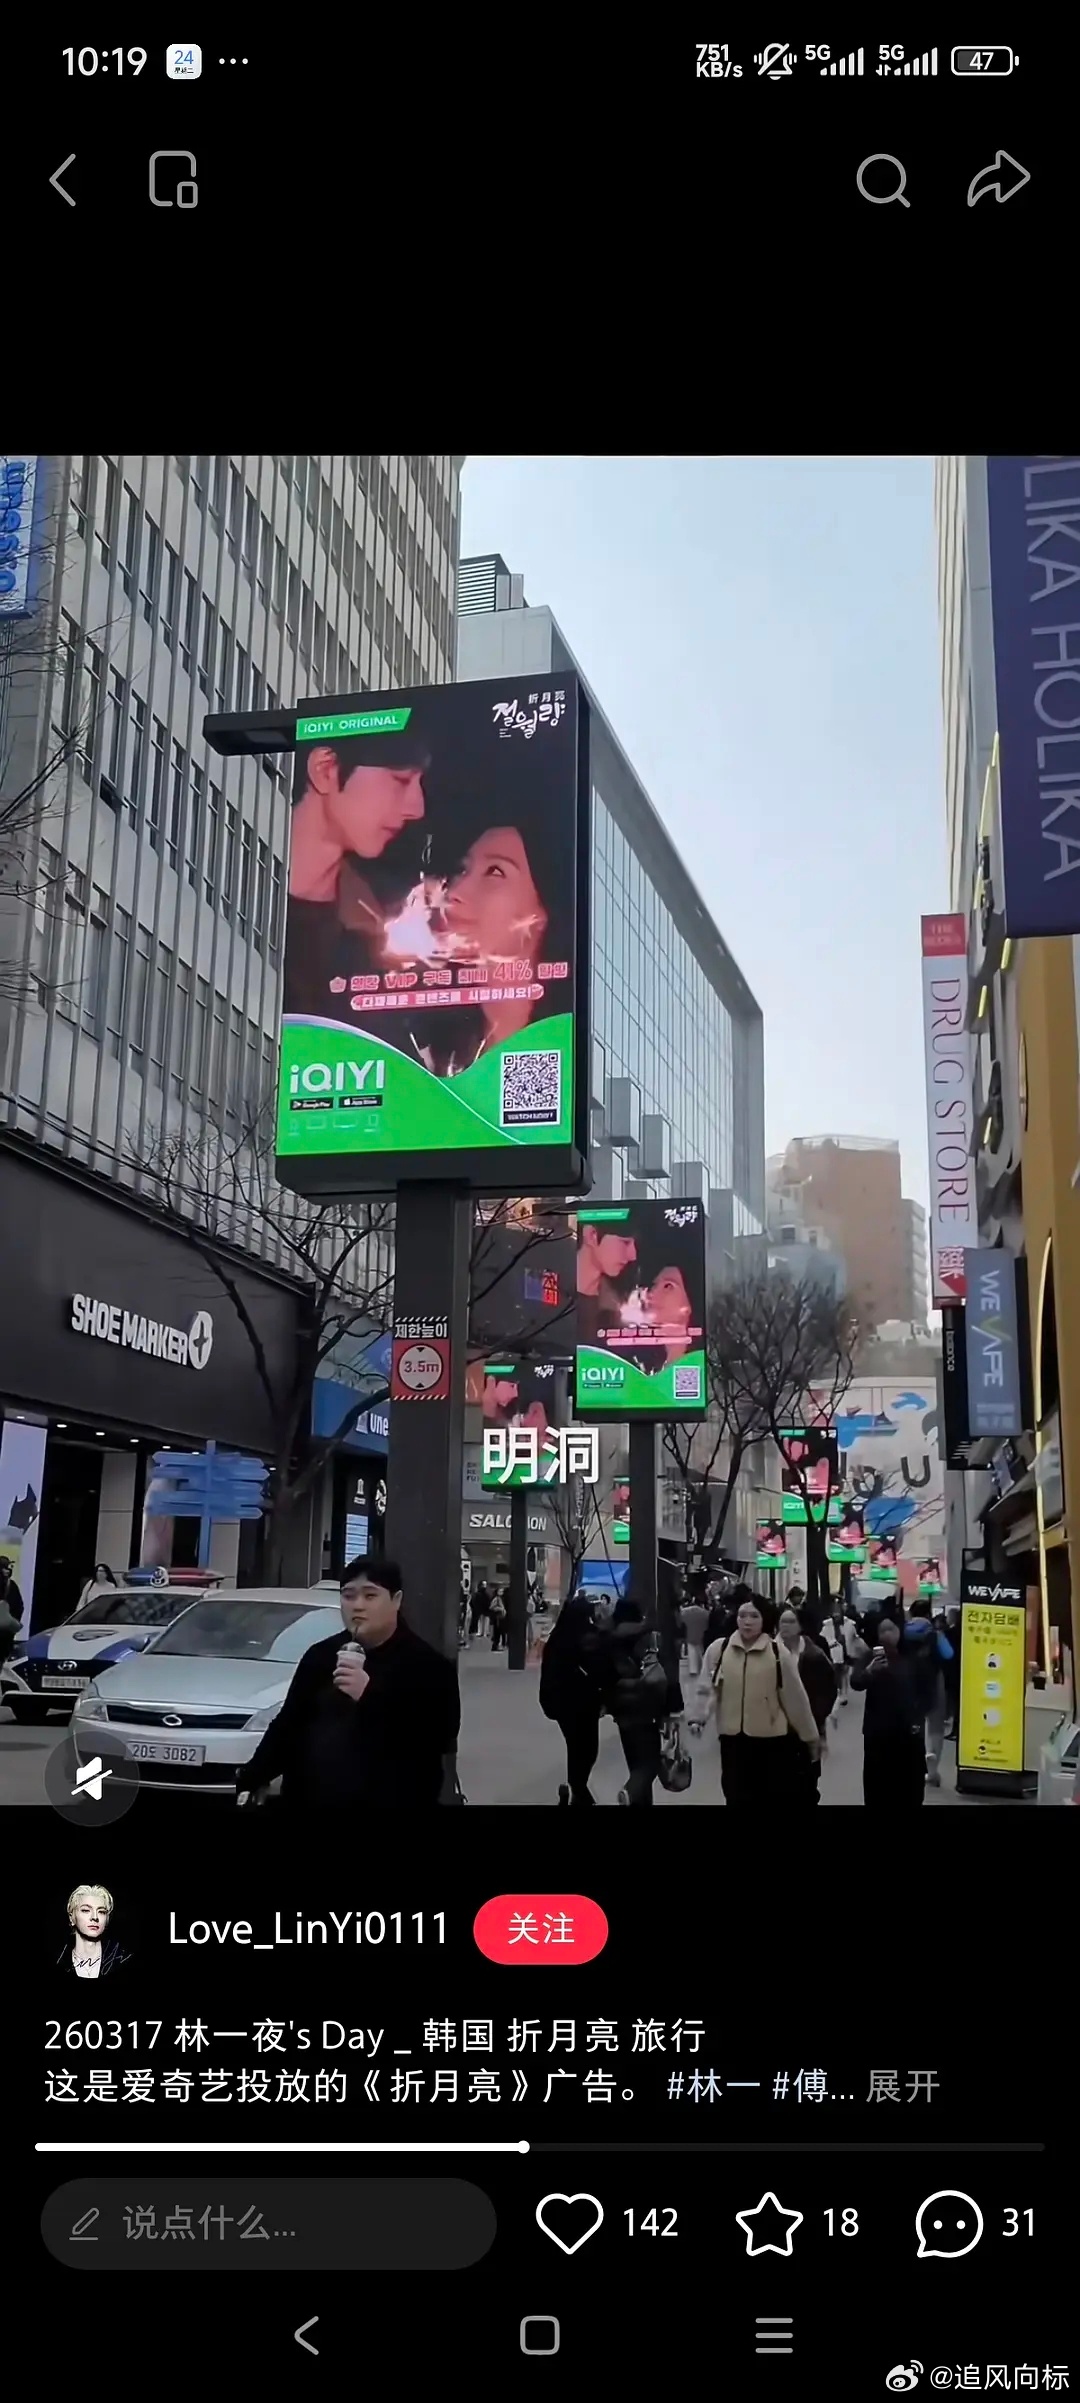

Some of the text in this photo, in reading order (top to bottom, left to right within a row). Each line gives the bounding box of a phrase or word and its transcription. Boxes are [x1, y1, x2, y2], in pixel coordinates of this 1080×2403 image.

[1024, 456, 1080, 882] LIKA HOLIKA
[339, 715, 398, 730] ORIGINAL
[385, 971, 417, 989] VIP
[930, 979, 964, 1084] DRUG
[289, 1060, 385, 1094] iQIYI
[935, 1099, 970, 1223] STORE
[404, 1361, 440, 1373] 3.5m
[369, 1412, 390, 1437] une
[163, 1746, 197, 1762] 3082
